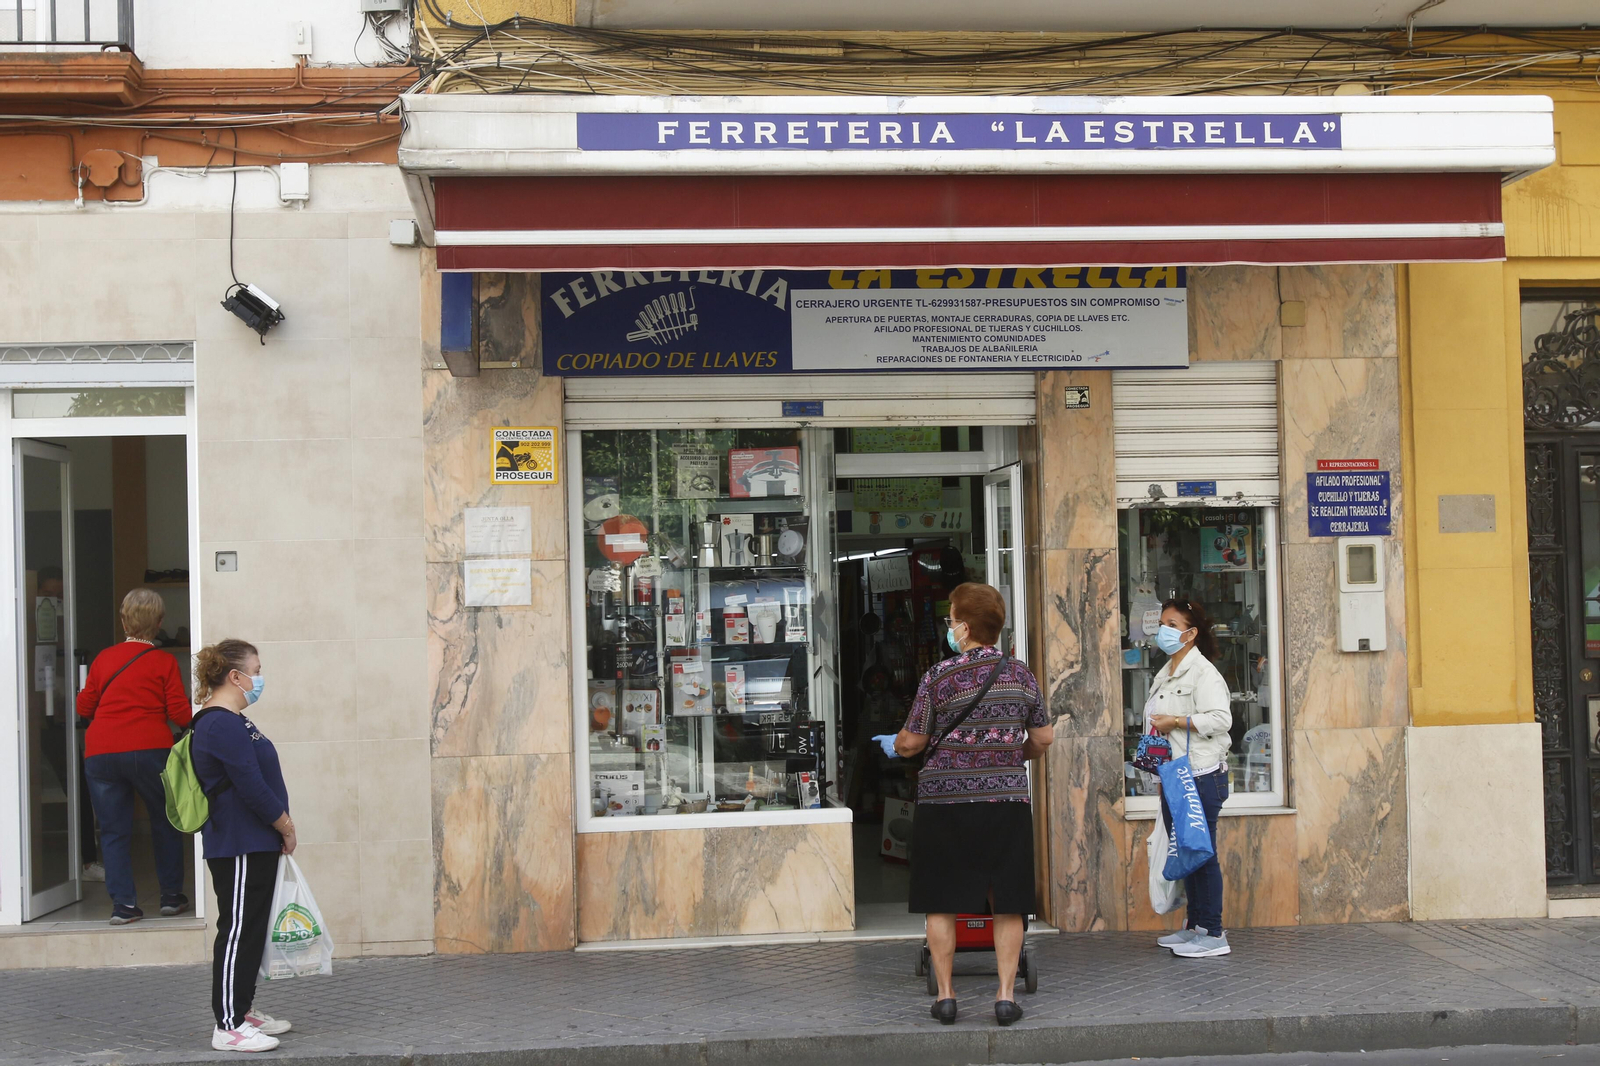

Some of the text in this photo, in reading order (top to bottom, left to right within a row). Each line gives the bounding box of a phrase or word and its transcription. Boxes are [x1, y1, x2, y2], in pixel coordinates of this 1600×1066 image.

[657, 120, 956, 144] FERRETERIA
[795, 299, 860, 309] CERRAJERO
[863, 299, 913, 308] URGENTE
[1070, 298, 1087, 307] SIN
[1089, 297, 1161, 307] COMPROMISO
[825, 316, 872, 324] APERTURA
[887, 315, 929, 324] PUERTAS,
[931, 315, 971, 323] MONTAJE
[973, 314, 1034, 323] CERRADURAS,
[1036, 314, 1062, 322] COPIA
[1063, 314, 1075, 322] DE
[1077, 314, 1109, 322] LLAVES
[1111, 314, 1130, 322] ETC.
[874, 325, 911, 333] AFILADO
[913, 325, 973, 333] PROFESIONAL
[1033, 324, 1083, 332] CUCHILLOS.
[912, 334, 1046, 343] MANTENIMIENTO COMUNIDADES
[921, 343, 1038, 353] TRABAJOS DE ALBAÑILERIA
[556, 351, 778, 371] COPIADO DE LLAVES
[876, 355, 943, 363] REPARACIONES
[945, 355, 956, 363] DE
[958, 355, 1013, 363] FONTANERIA
[1014, 354, 1020, 362] Y
[1021, 354, 1082, 362] ELECTRICIDAD
[496, 472, 552, 480] PROSEGUR
[1316, 475, 1381, 486] AFILADO PROFESIONAL
[1318, 491, 1379, 502] CUCHILLO Y TIJERAS
[1311, 506, 1387, 516] SE REALIZAN TRABAJOS DE
[1330, 522, 1369, 532] CERRAJERIA
[1177, 766, 1206, 833] Marlene
